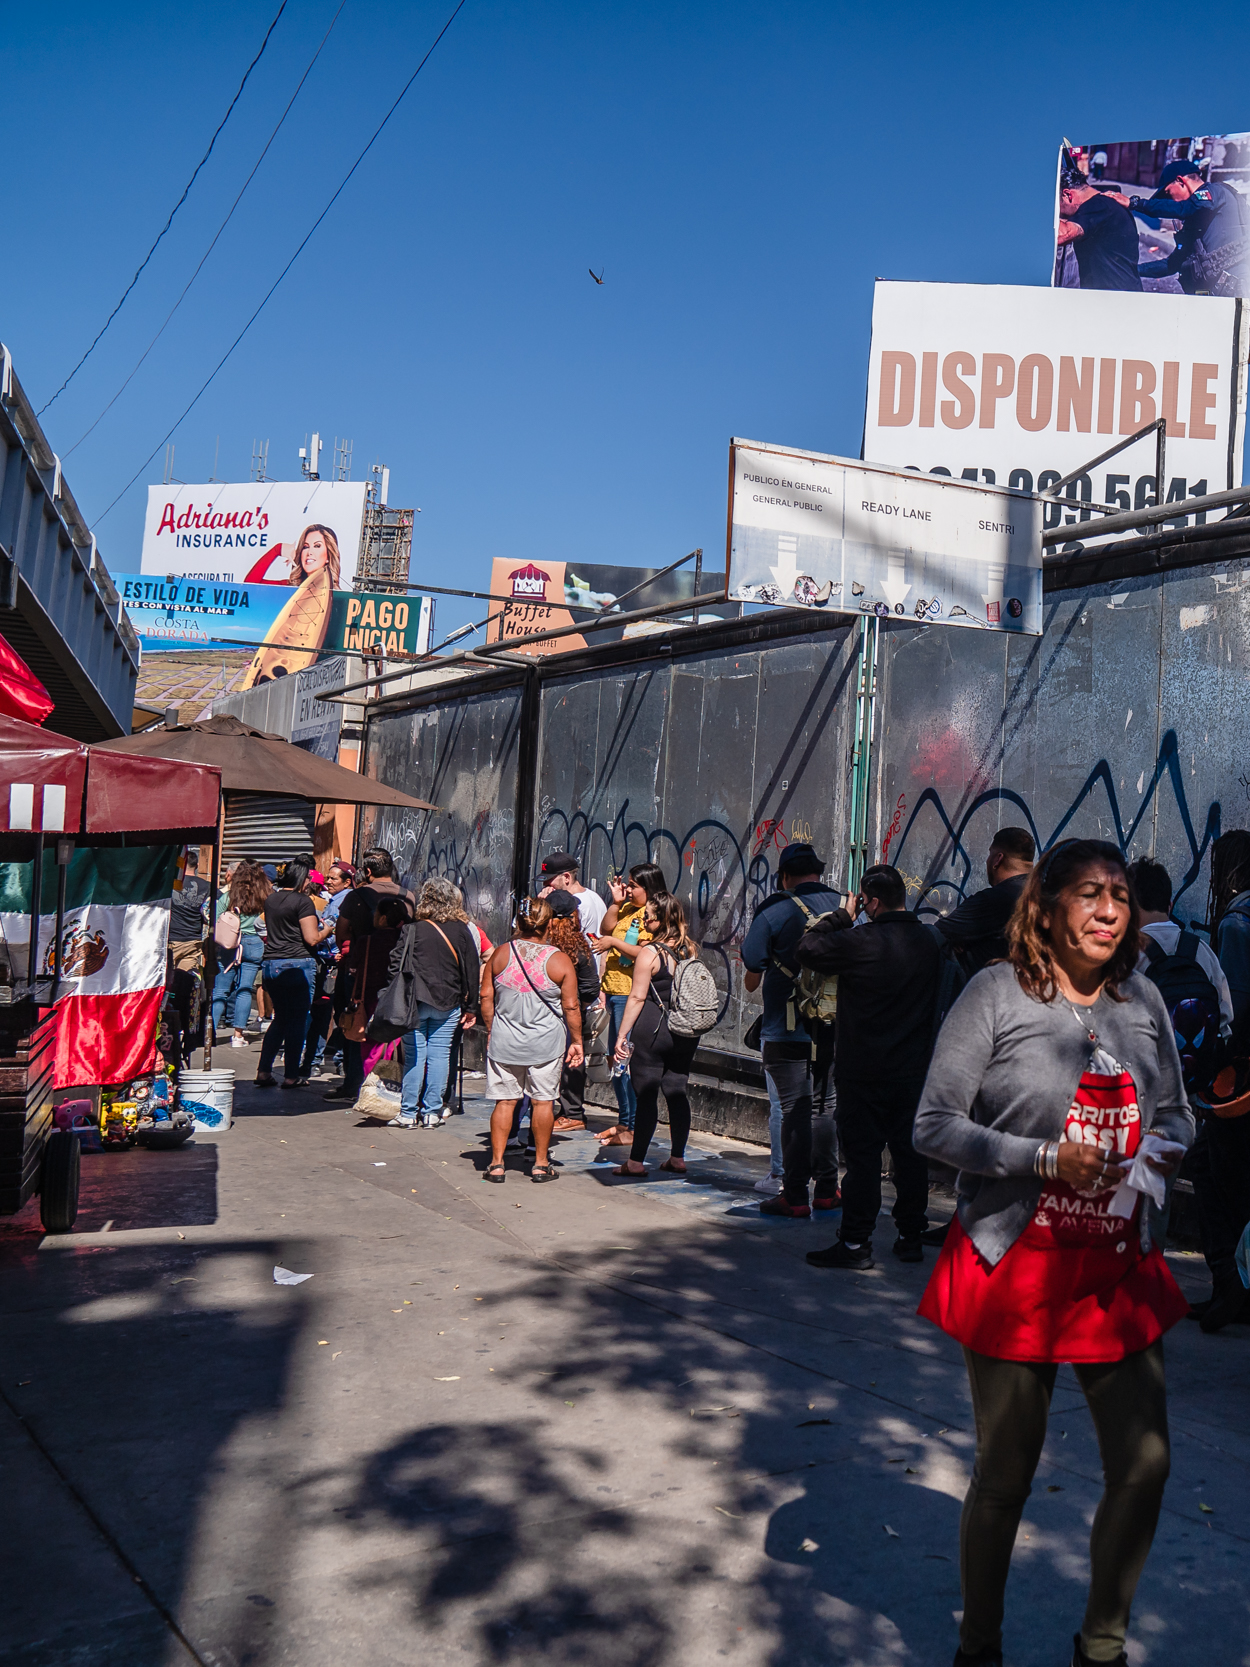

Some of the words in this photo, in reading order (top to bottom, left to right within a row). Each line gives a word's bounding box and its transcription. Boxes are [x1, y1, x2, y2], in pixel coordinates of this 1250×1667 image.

[878, 350, 1219, 441] DISPONIBLE
[744, 473, 780, 486] PUBLICO
[794, 482, 833, 495] GENERAL
[752, 494, 792, 508] GENERAL
[794, 500, 823, 512] PUBLIC
[861, 500, 900, 516] READY
[902, 507, 932, 522] LANE
[156, 502, 269, 536] Adriana's
[978, 520, 1015, 535] SENTRI
[176, 534, 268, 548] INSURANCE
[123, 581, 179, 602] ESTILO
[185, 586, 206, 605] DE
[214, 588, 250, 608] VIDA
[123, 600, 140, 608] TES
[142, 602, 163, 610] CON
[165, 603, 192, 612] VISTA
[194, 606, 205, 614] AL
[206, 607, 228, 615] MAR
[346, 598, 410, 630] PAGO
[503, 602, 552, 622] Buffet
[154, 616, 200, 630] COSTA
[146, 627, 208, 642] DORADA
[343, 626, 408, 653] INICIAL
[300, 698, 310, 722] EN
[384, 1082, 402, 1092] AZY
[1066, 1102, 1140, 1126] RRITOS
[1059, 1121, 1130, 1155] OSSY
[1038, 1192, 1112, 1217] TAMAL
[1034, 1210, 1052, 1228] &
